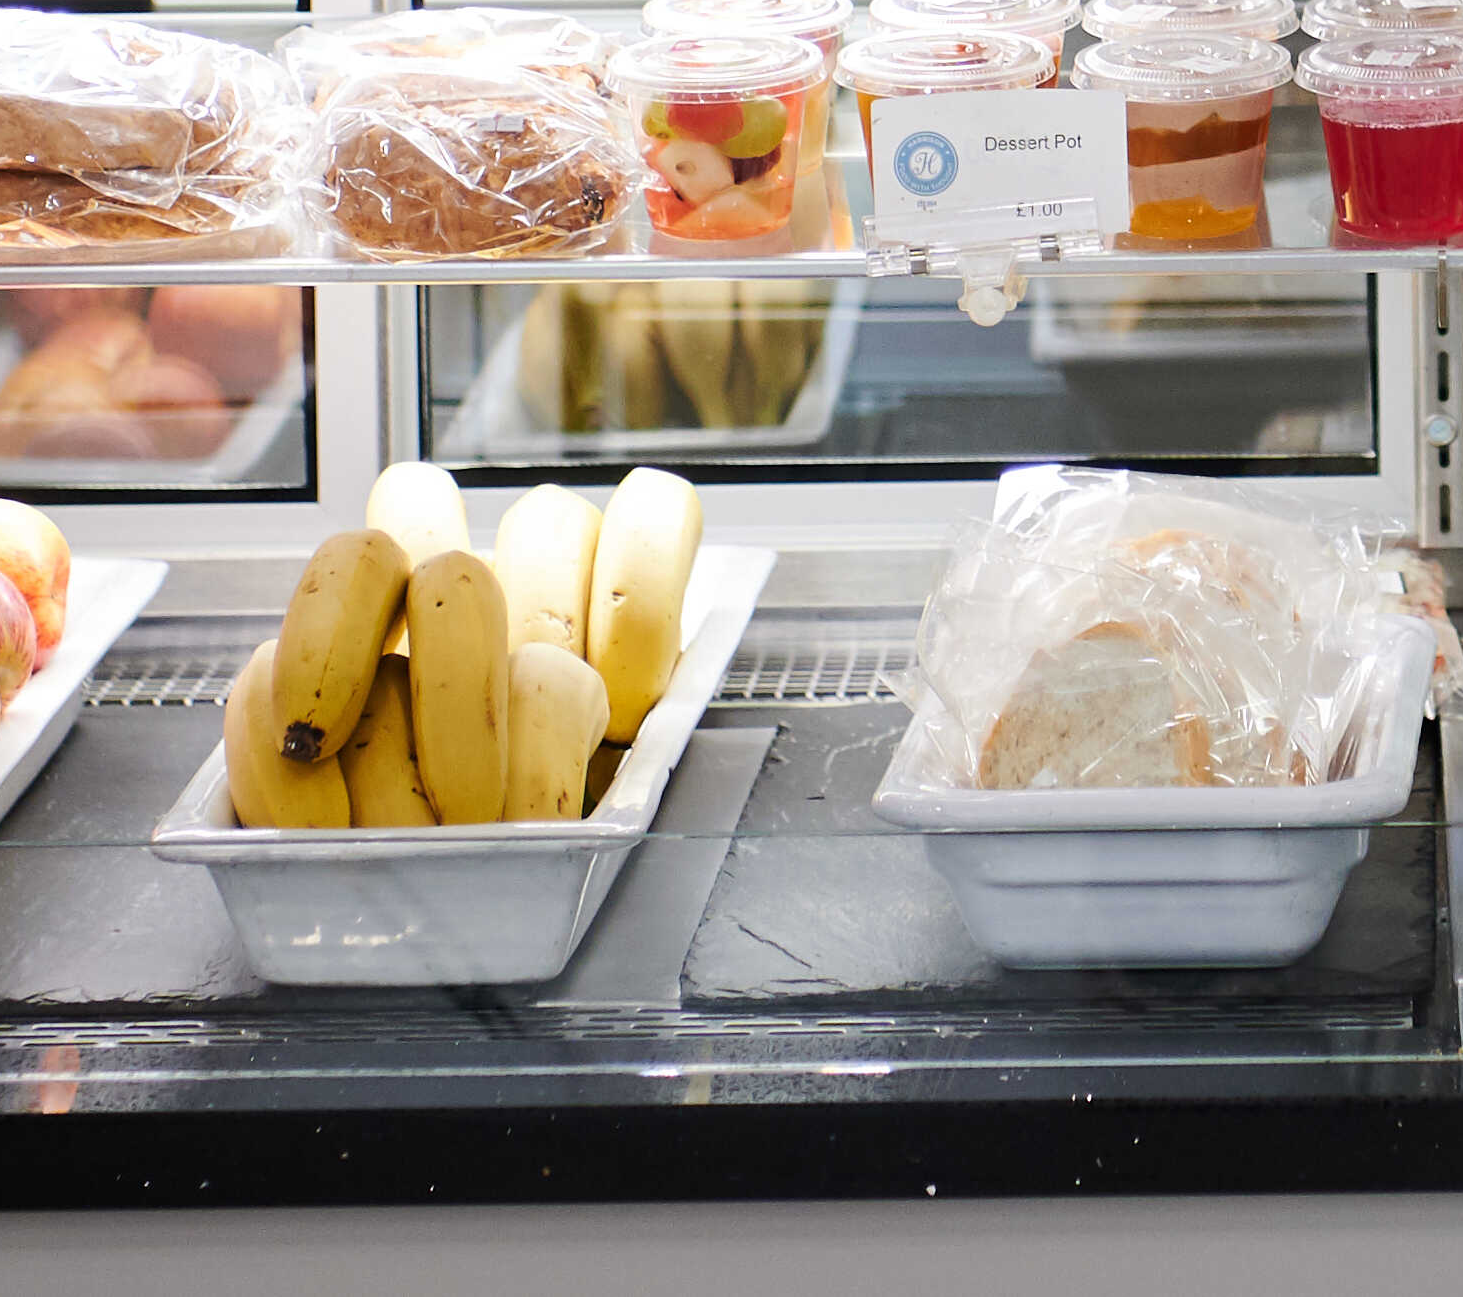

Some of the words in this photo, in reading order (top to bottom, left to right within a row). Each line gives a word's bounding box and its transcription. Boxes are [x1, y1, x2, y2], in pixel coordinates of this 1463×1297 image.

[985, 136, 1050, 151] Dessert
[1055, 134, 1081, 149] Pot
[1017, 202, 1062, 217] £1.00
